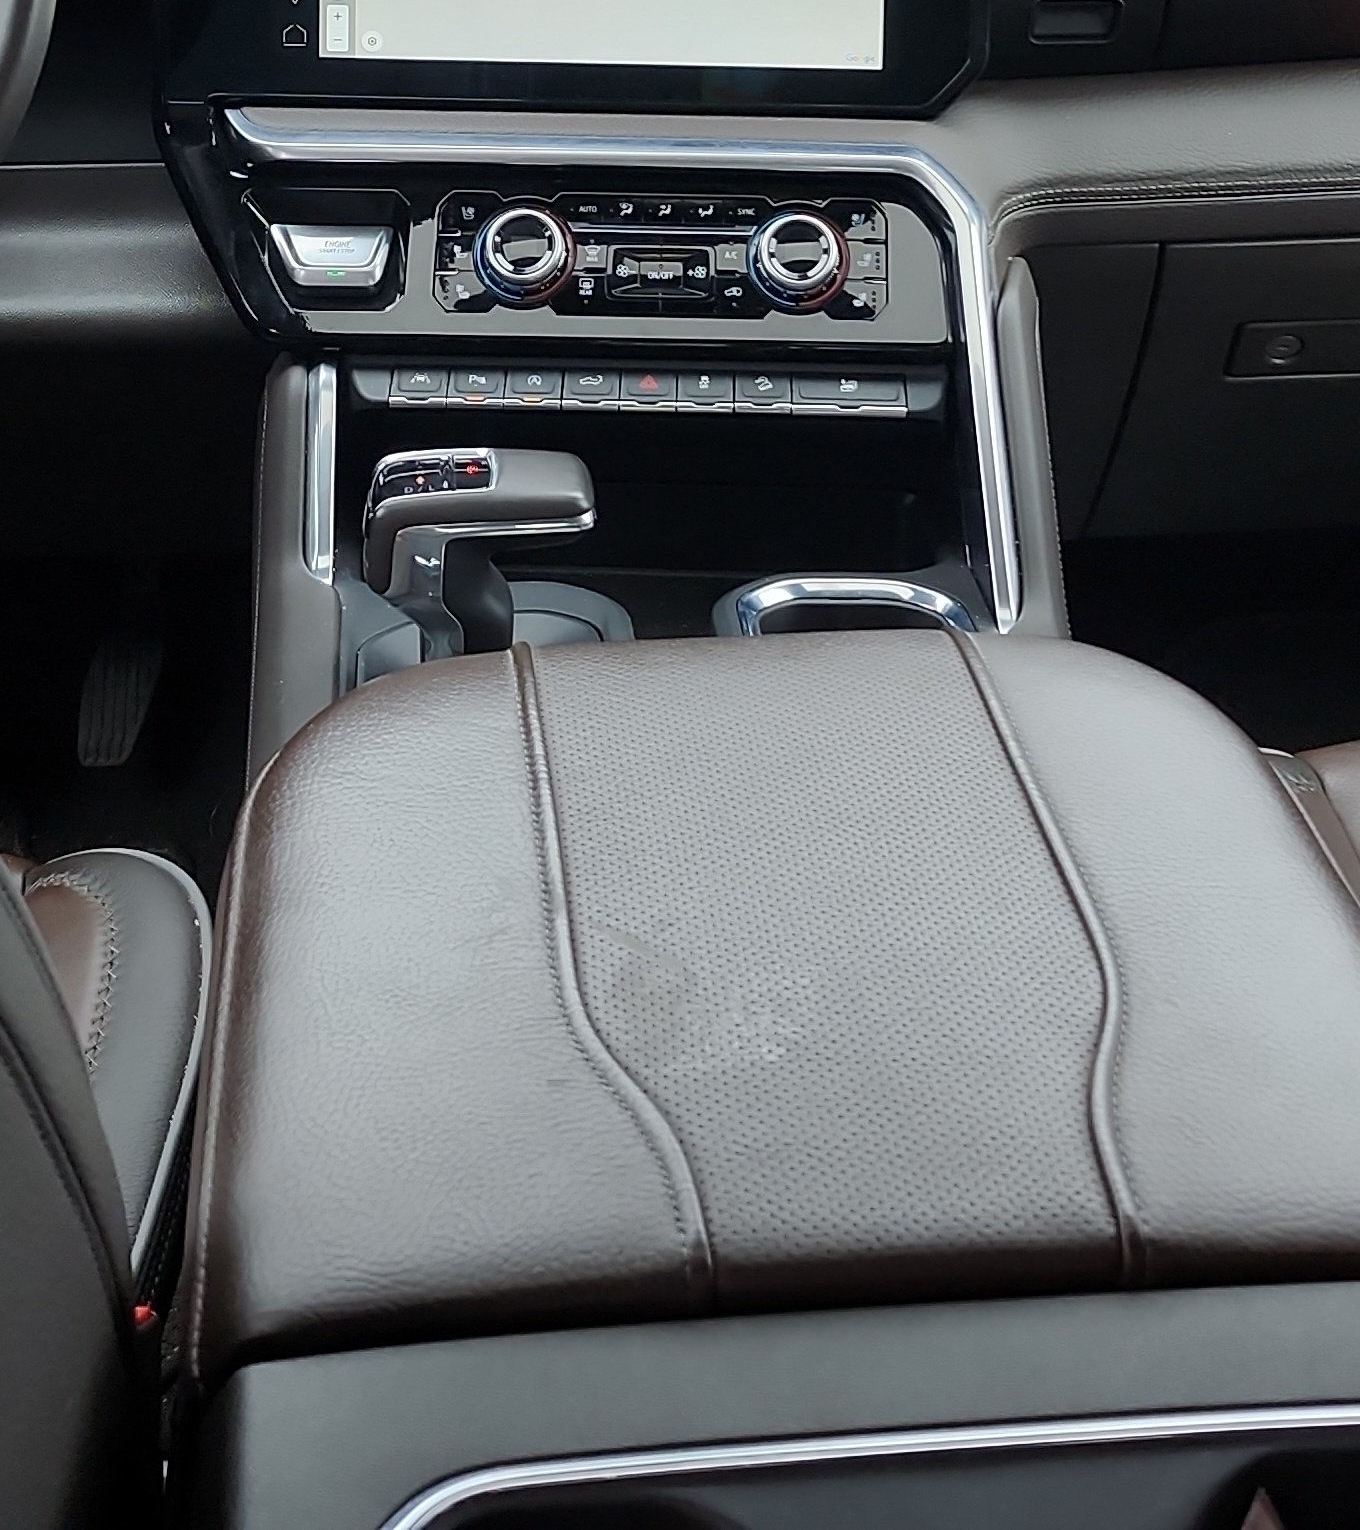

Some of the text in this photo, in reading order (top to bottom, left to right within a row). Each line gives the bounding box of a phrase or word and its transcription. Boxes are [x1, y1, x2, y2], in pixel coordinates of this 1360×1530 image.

[737, 208, 756, 216] SYNC
[324, 240, 351, 248] ENGINE
[724, 252, 738, 260] A/C
[648, 271, 674, 280] ON/OFF
